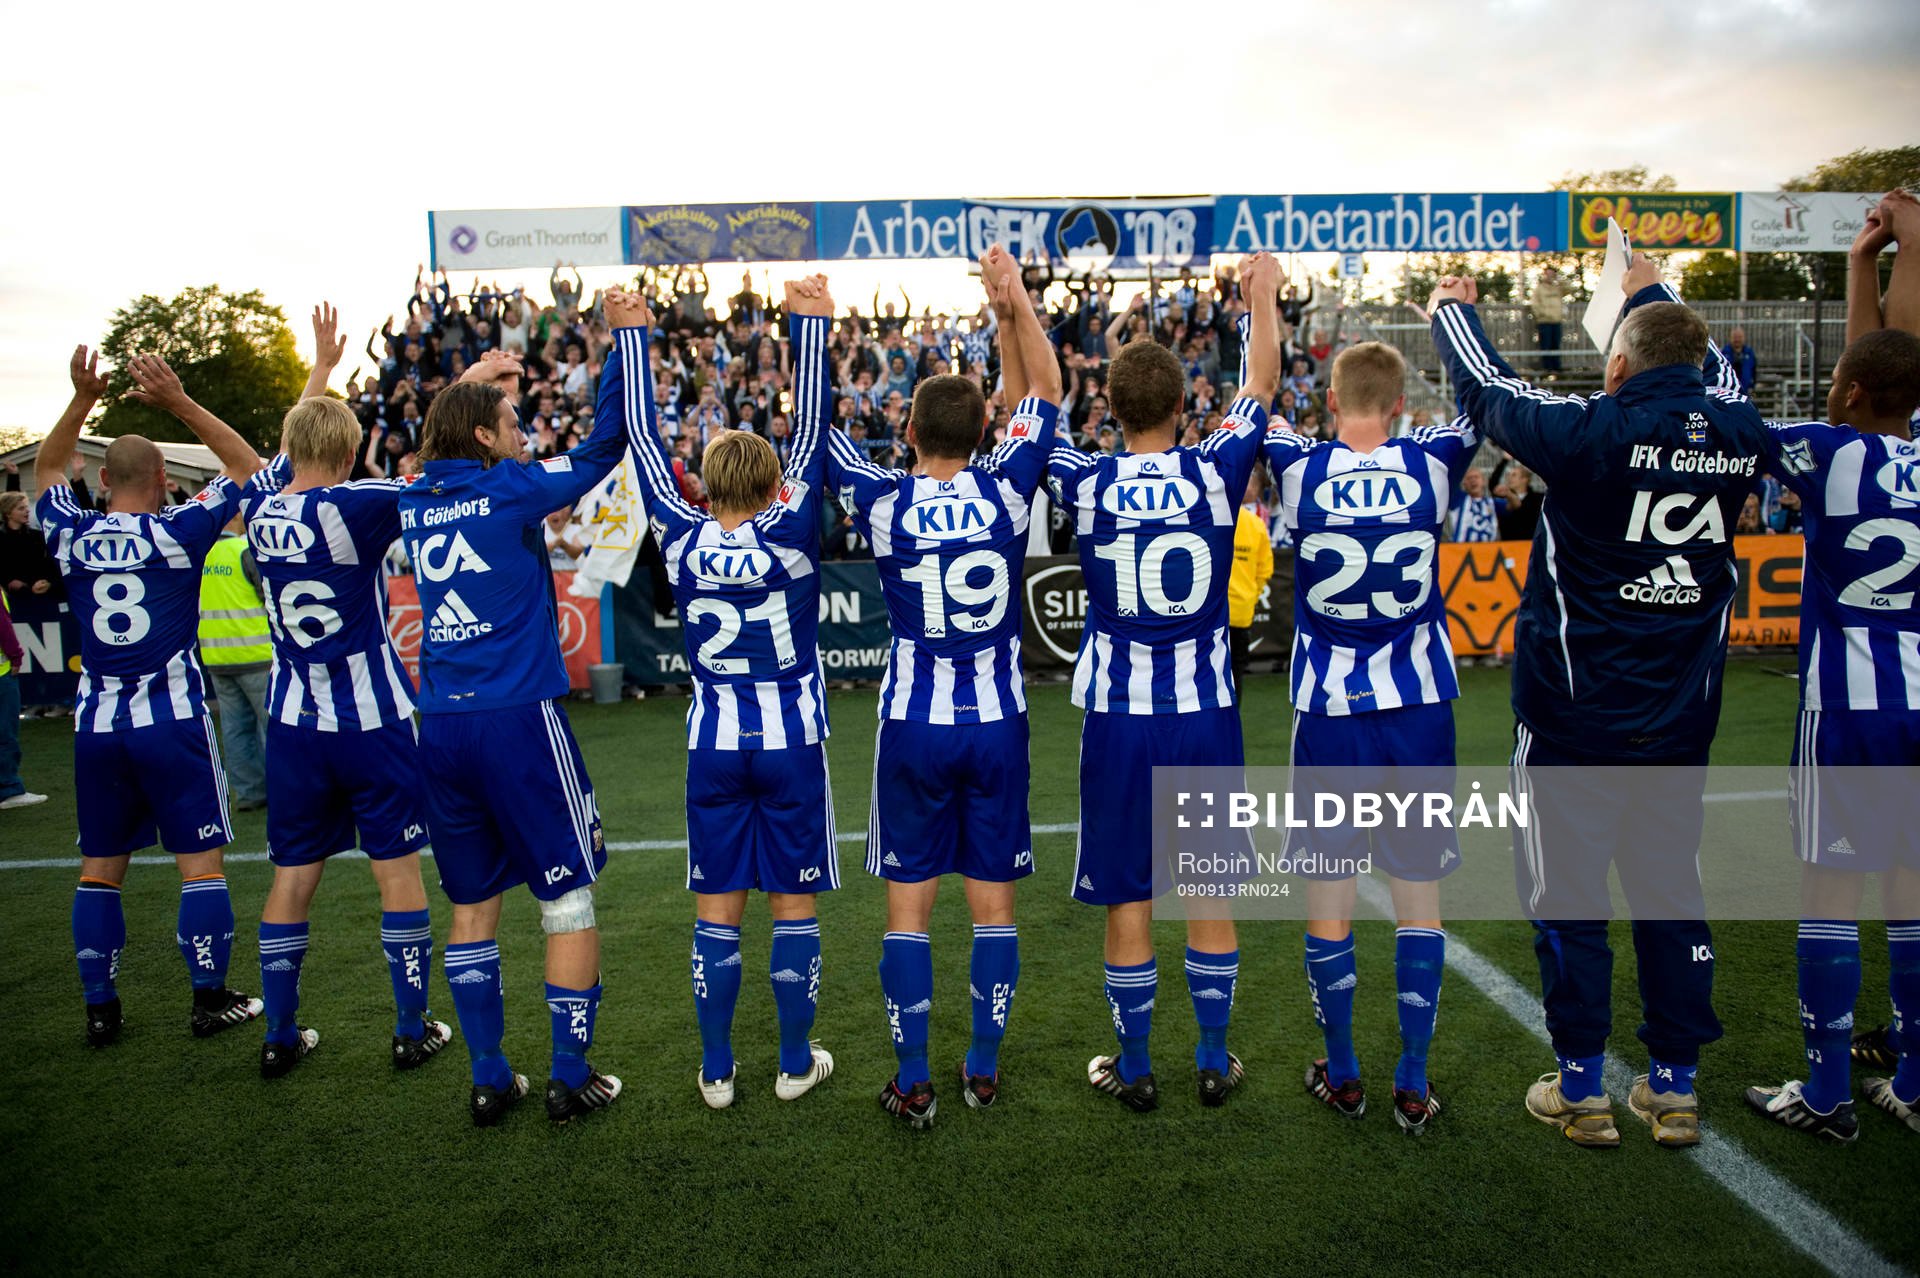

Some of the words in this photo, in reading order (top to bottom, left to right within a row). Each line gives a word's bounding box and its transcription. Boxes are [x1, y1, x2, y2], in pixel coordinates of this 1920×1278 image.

[1581, 197, 1722, 246] Cheers
[485, 231, 533, 248] Grant
[534, 228, 608, 246] Thornton
[1344, 256, 1359, 275] E
[1684, 420, 1708, 429] 2009
[1688, 412, 1704, 421] ICA
[1895, 444, 1915, 456] ICA
[1140, 461, 1160, 472] ICA
[1358, 460, 1378, 468] ICA
[1629, 445, 1662, 469] IFK
[1671, 448, 1758, 477] Göteborg
[938, 481, 955, 491] ICA
[1116, 482, 1186, 511] KIA
[1332, 477, 1406, 509] KIA
[269, 500, 287, 511] ICA
[423, 496, 491, 526] Göteborg
[916, 501, 986, 533] KIA
[1625, 490, 1726, 545] ICA
[251, 525, 304, 551] KIA
[720, 530, 736, 541] ICA
[83, 538, 141, 562] KIA
[411, 529, 492, 584] ICA
[699, 551, 759, 577] KIA
[1095, 532, 1212, 617] 10
[1300, 530, 1435, 620] 23
[901, 550, 1010, 638] 19
[1618, 582, 1701, 605] adidas
[1870, 596, 1891, 607] ICA
[93, 572, 150, 645] 8
[1169, 605, 1187, 614] ICA
[1324, 605, 1342, 616] ICA
[428, 621, 493, 643] adidas
[687, 590, 797, 675] 21
[972, 619, 989, 629] ICA
[1047, 622, 1058, 630] OF
[114, 635, 129, 643] ICA
[656, 654, 691, 672] TA
[712, 662, 728, 672] ICA
[198, 823, 222, 840] ICA
[403, 823, 423, 842] ICA
[545, 864, 574, 885] ICA
[799, 866, 821, 882] ICA
[193, 935, 214, 971] SKF
[403, 946, 422, 990] SKF
[992, 983, 1009, 1028] SKF
